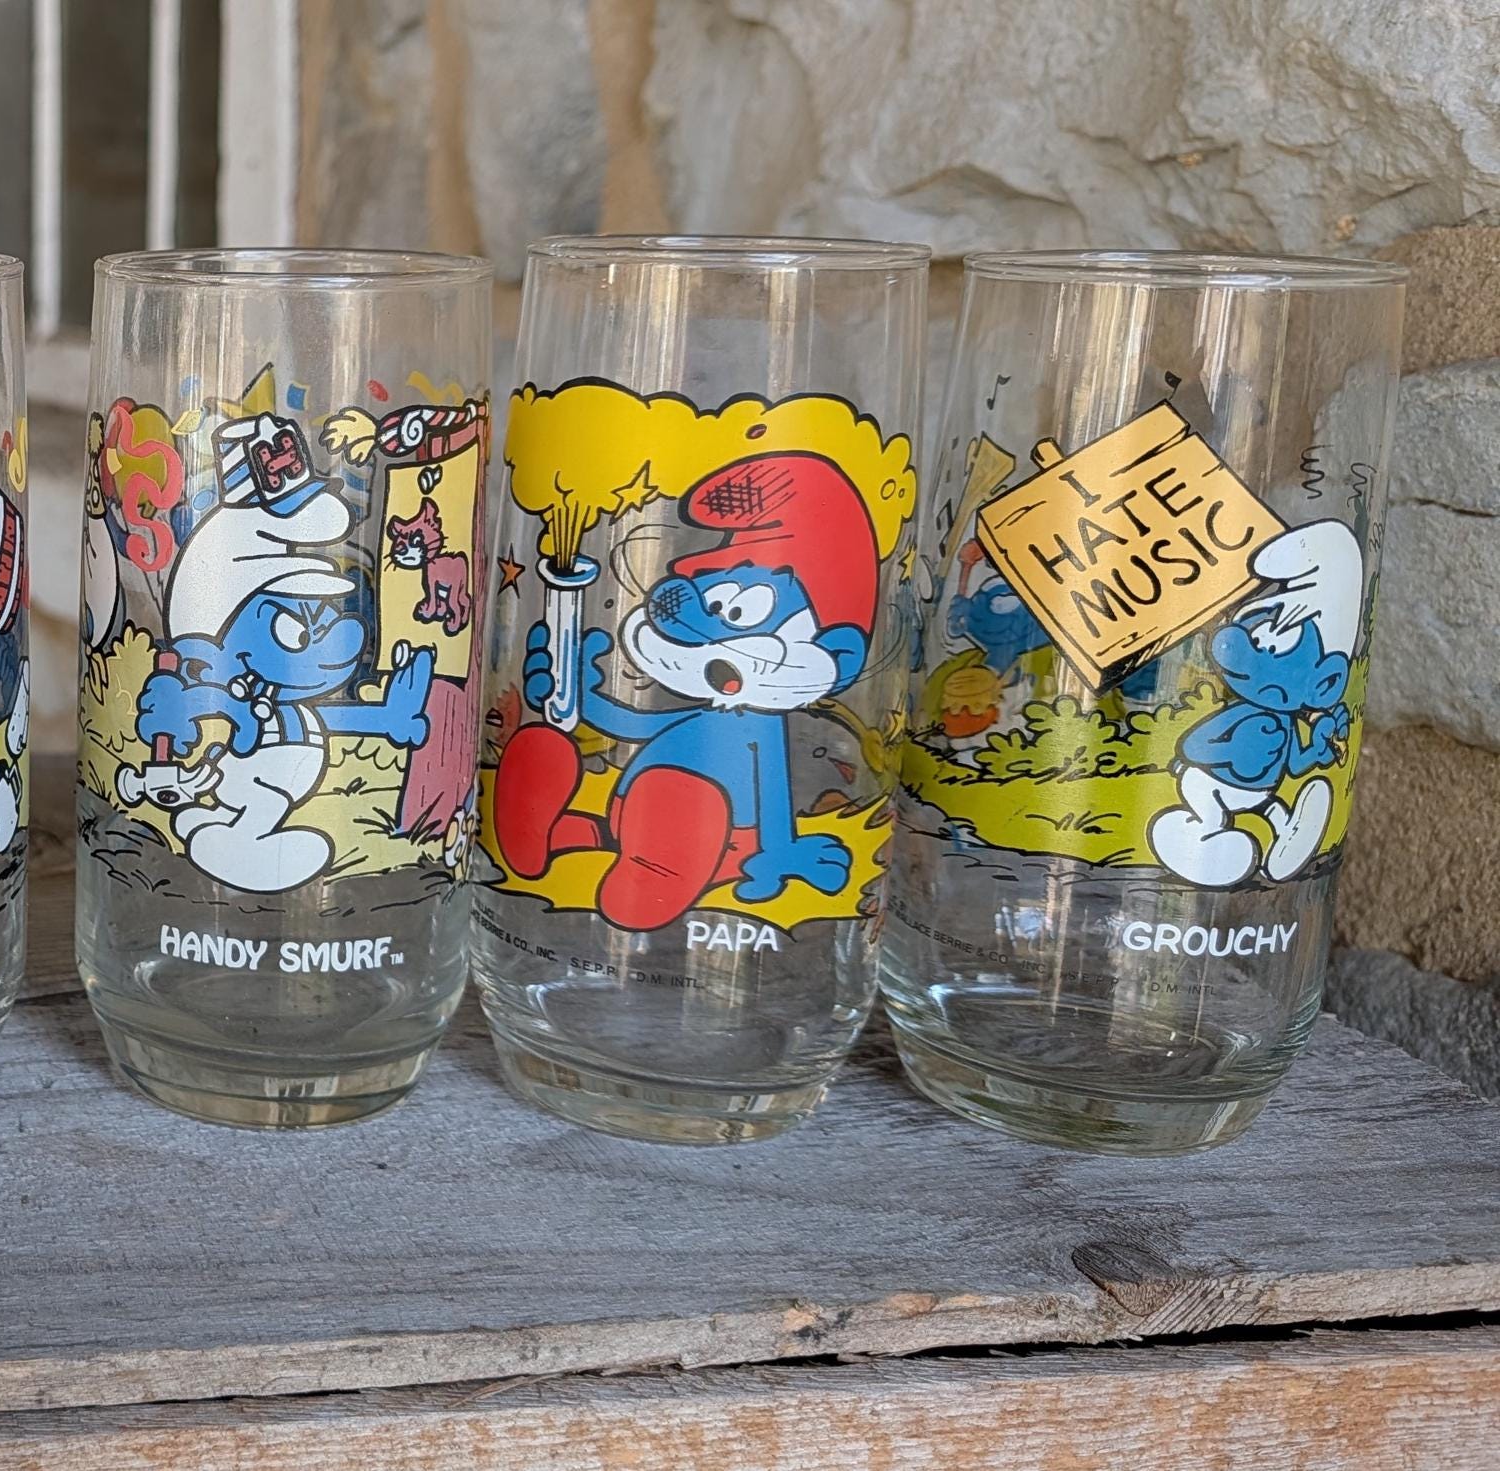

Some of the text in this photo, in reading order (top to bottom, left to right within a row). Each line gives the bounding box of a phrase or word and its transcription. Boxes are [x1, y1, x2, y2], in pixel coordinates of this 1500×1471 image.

[1058, 469, 1102, 508] I
[1028, 466, 1205, 585] HATE
[1069, 500, 1255, 639] MUSIC
[160, 924, 268, 971] HANDY
[278, 936, 392, 973] SMURF
[686, 920, 780, 953] PAPA
[933, 929, 973, 955] BERRIE
[976, 947, 985, 957] &
[1121, 921, 1298, 957] GROUCHY
